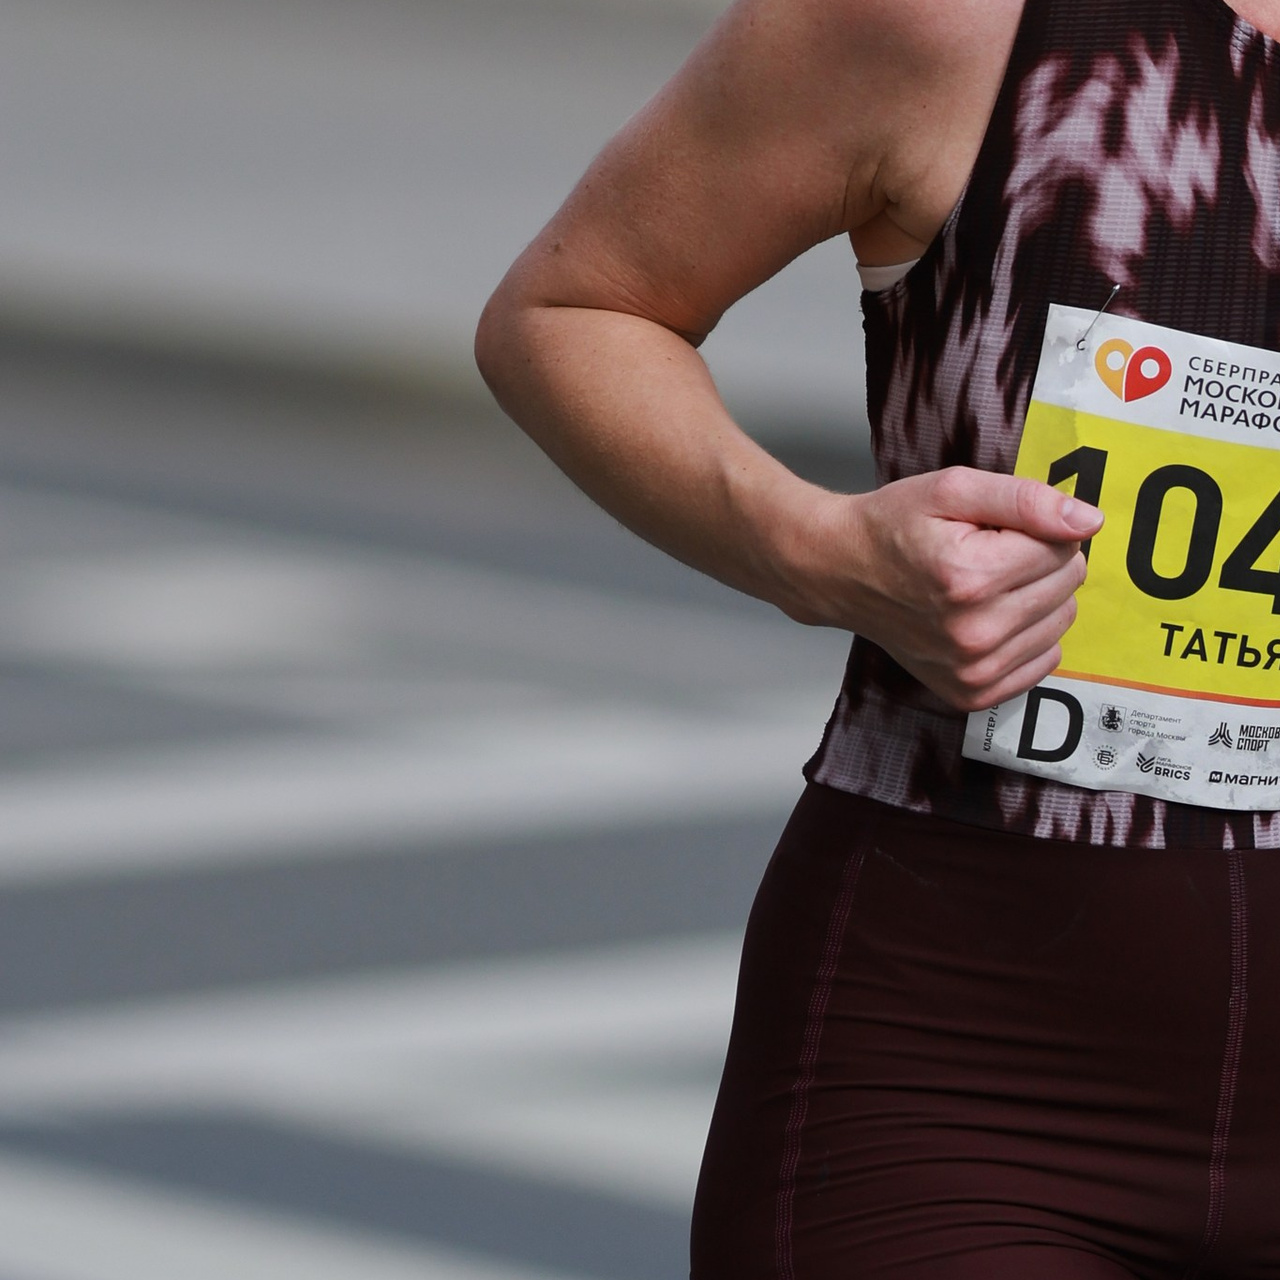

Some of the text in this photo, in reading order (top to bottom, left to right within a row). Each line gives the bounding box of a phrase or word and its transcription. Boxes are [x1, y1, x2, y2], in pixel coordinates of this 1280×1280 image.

[1129, 718, 1156, 729] спорта
[1130, 709, 1182, 724] Департамент
[1016, 686, 1084, 763] D
[982, 716, 997, 752] КЛАСТЕР
[1128, 726, 1187, 742] города Москвы
[1236, 737, 1270, 752] СПОРТ
[1154, 766, 1191, 781] BRICS
